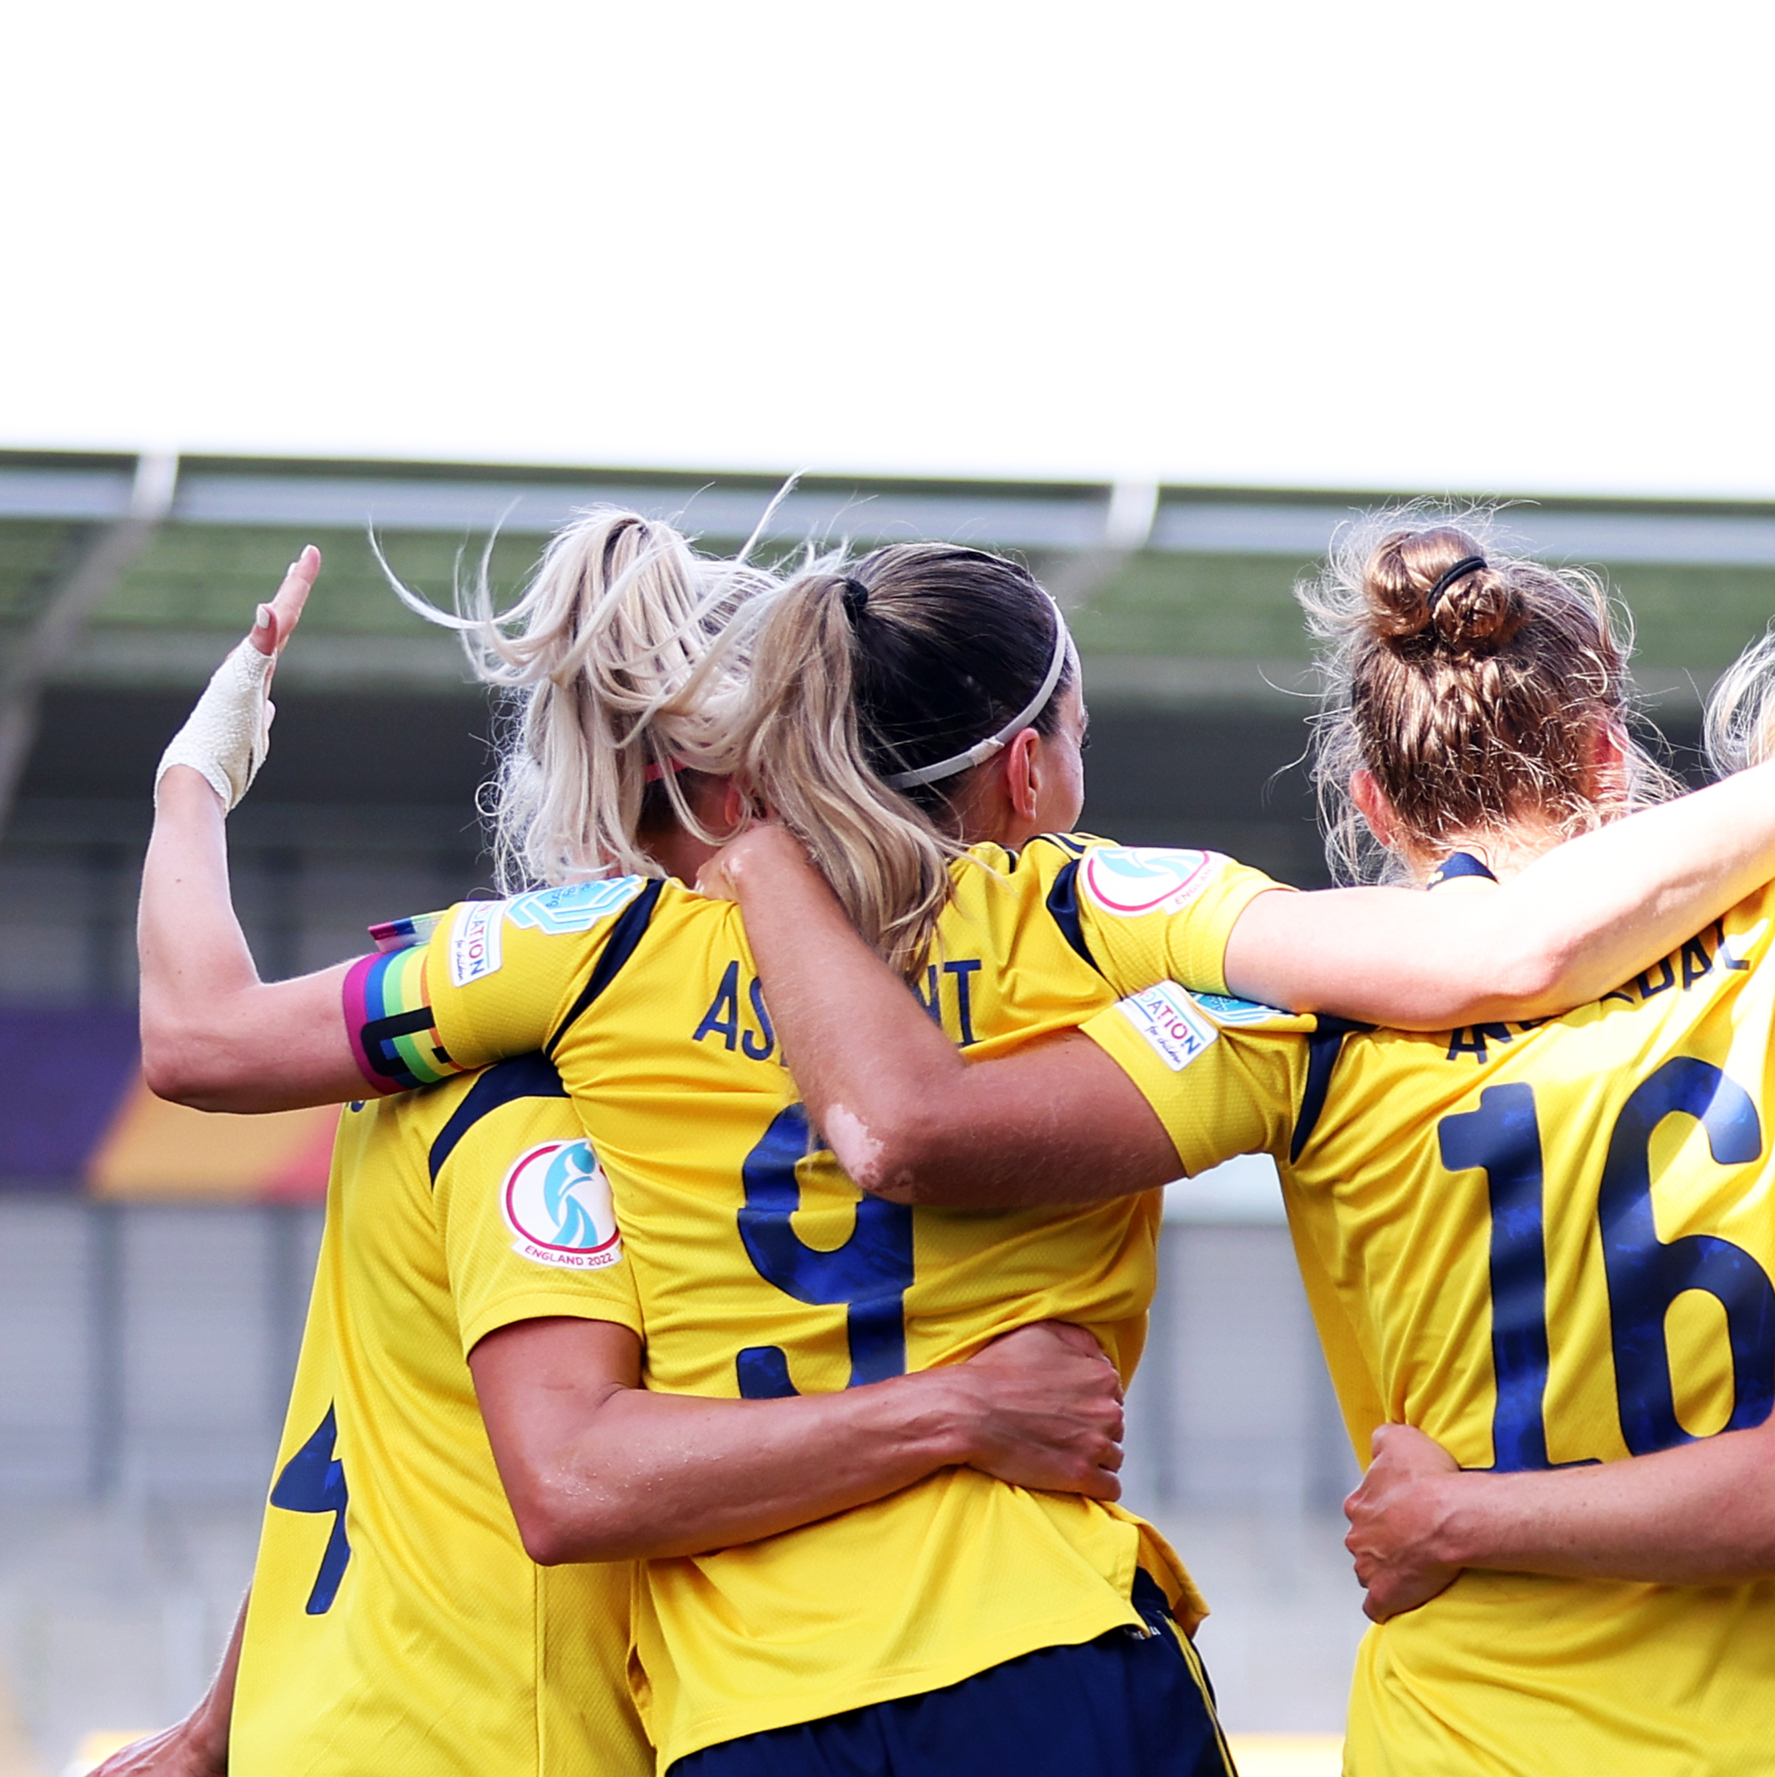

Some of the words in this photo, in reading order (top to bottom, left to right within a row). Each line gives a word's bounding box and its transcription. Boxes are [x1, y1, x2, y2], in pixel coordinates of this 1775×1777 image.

[525, 1245, 584, 1266] ENGLAND
[587, 1252, 614, 1267] 2022
[737, 1101, 914, 1400] 9
